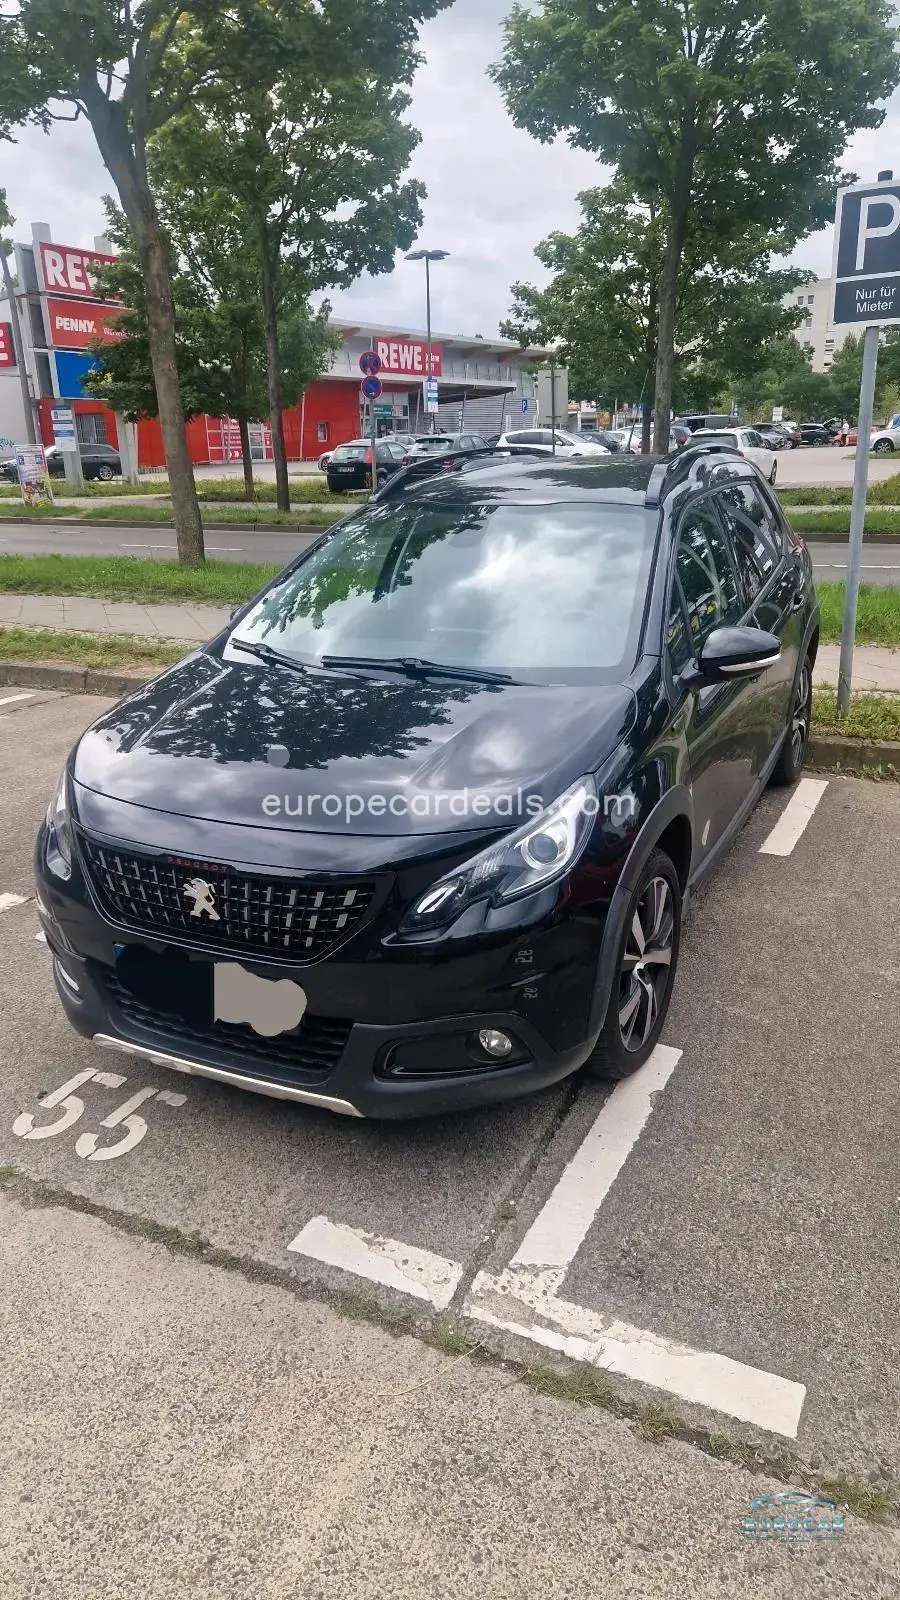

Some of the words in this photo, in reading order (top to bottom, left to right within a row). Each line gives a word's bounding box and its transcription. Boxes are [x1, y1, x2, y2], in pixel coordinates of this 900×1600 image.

[855, 194, 900, 271] P
[44, 249, 116, 291] RE
[855, 288, 877, 300] Nur
[880, 286, 897, 298] für
[856, 300, 894, 313] Mieter
[377, 341, 423, 371] REWE
[167, 856, 229, 872] PEUGEOT
[12, 1067, 189, 1161] 55
